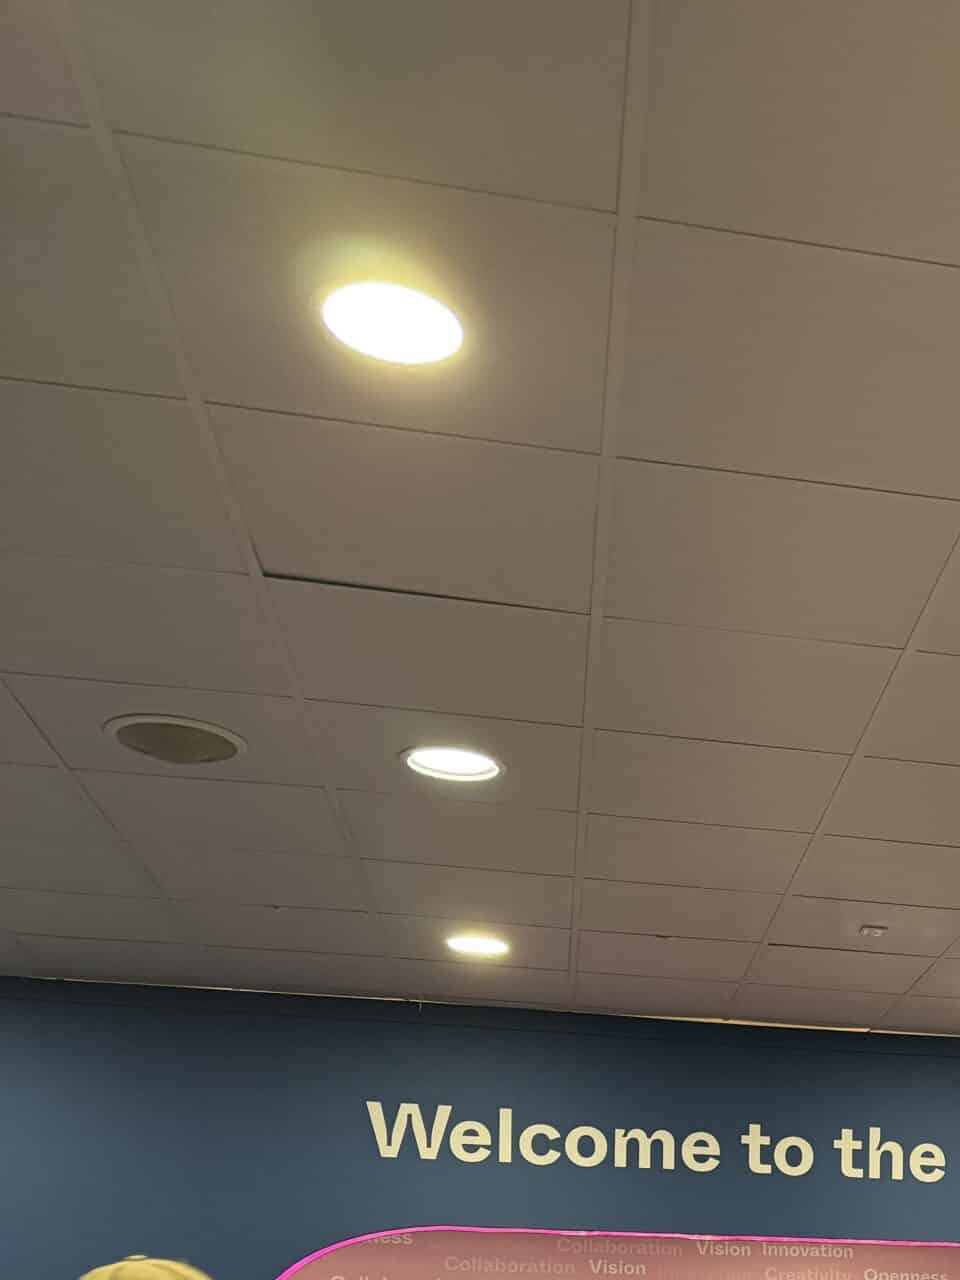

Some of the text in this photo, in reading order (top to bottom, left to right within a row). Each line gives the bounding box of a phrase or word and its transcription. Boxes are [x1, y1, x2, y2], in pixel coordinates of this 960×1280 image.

[366, 1101, 721, 1172] Welcome
[741, 1123, 814, 1177] to
[833, 1126, 946, 1183] the
[557, 1239, 854, 1260] Collaboration Vision Innovation
[444, 1256, 576, 1275] Collaboration
[588, 1259, 647, 1276] Vision
